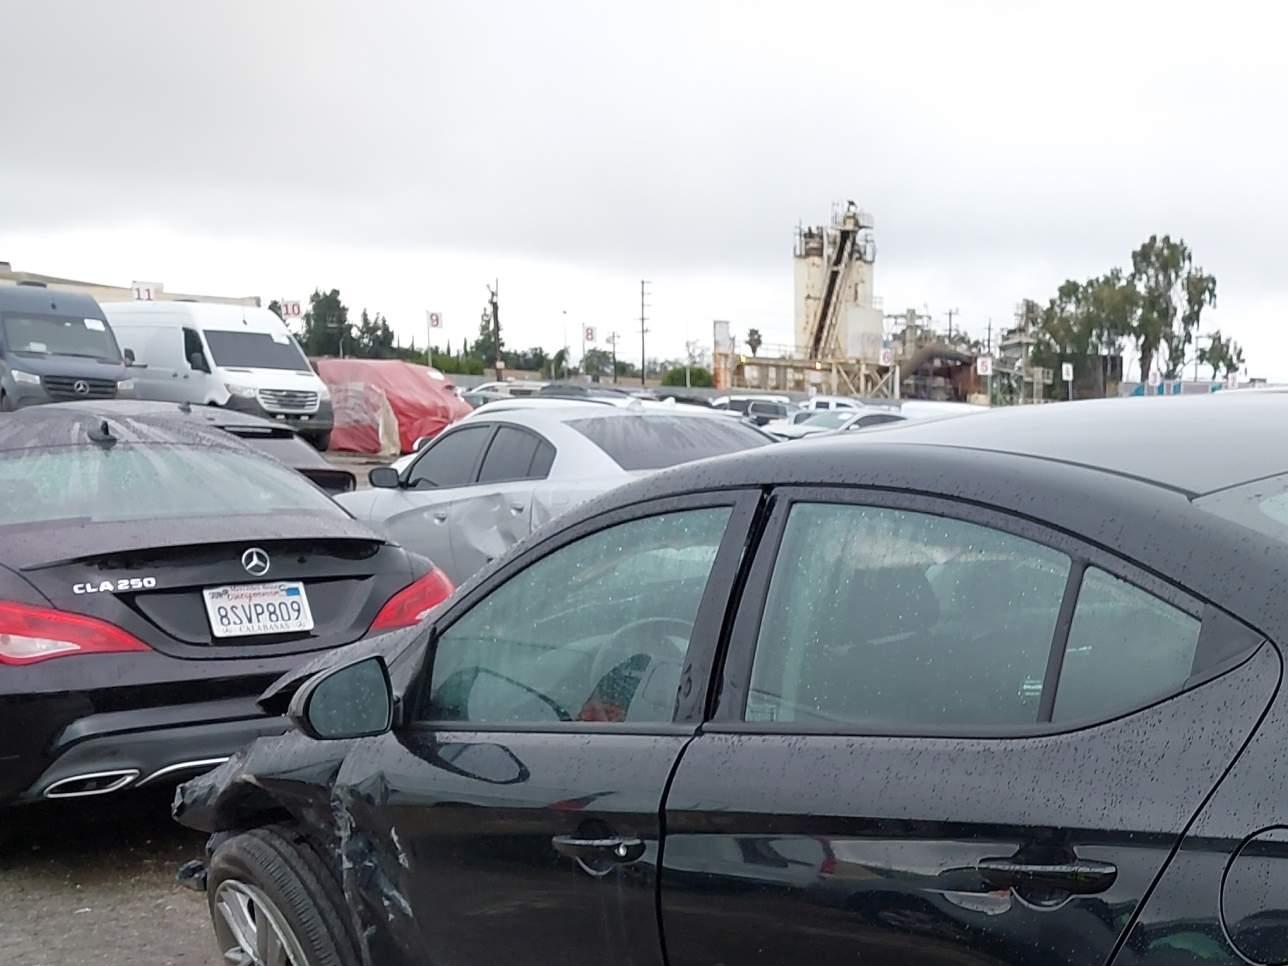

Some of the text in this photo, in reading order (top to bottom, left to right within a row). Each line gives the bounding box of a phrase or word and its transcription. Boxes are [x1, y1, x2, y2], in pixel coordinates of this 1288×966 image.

[135, 288, 152, 300] 11
[284, 303, 300, 316] 10
[430, 312, 440, 328] 9
[585, 327, 594, 341] 8
[73, 577, 156, 594] CLA 250
[218, 601, 301, 626] 8SVP809
